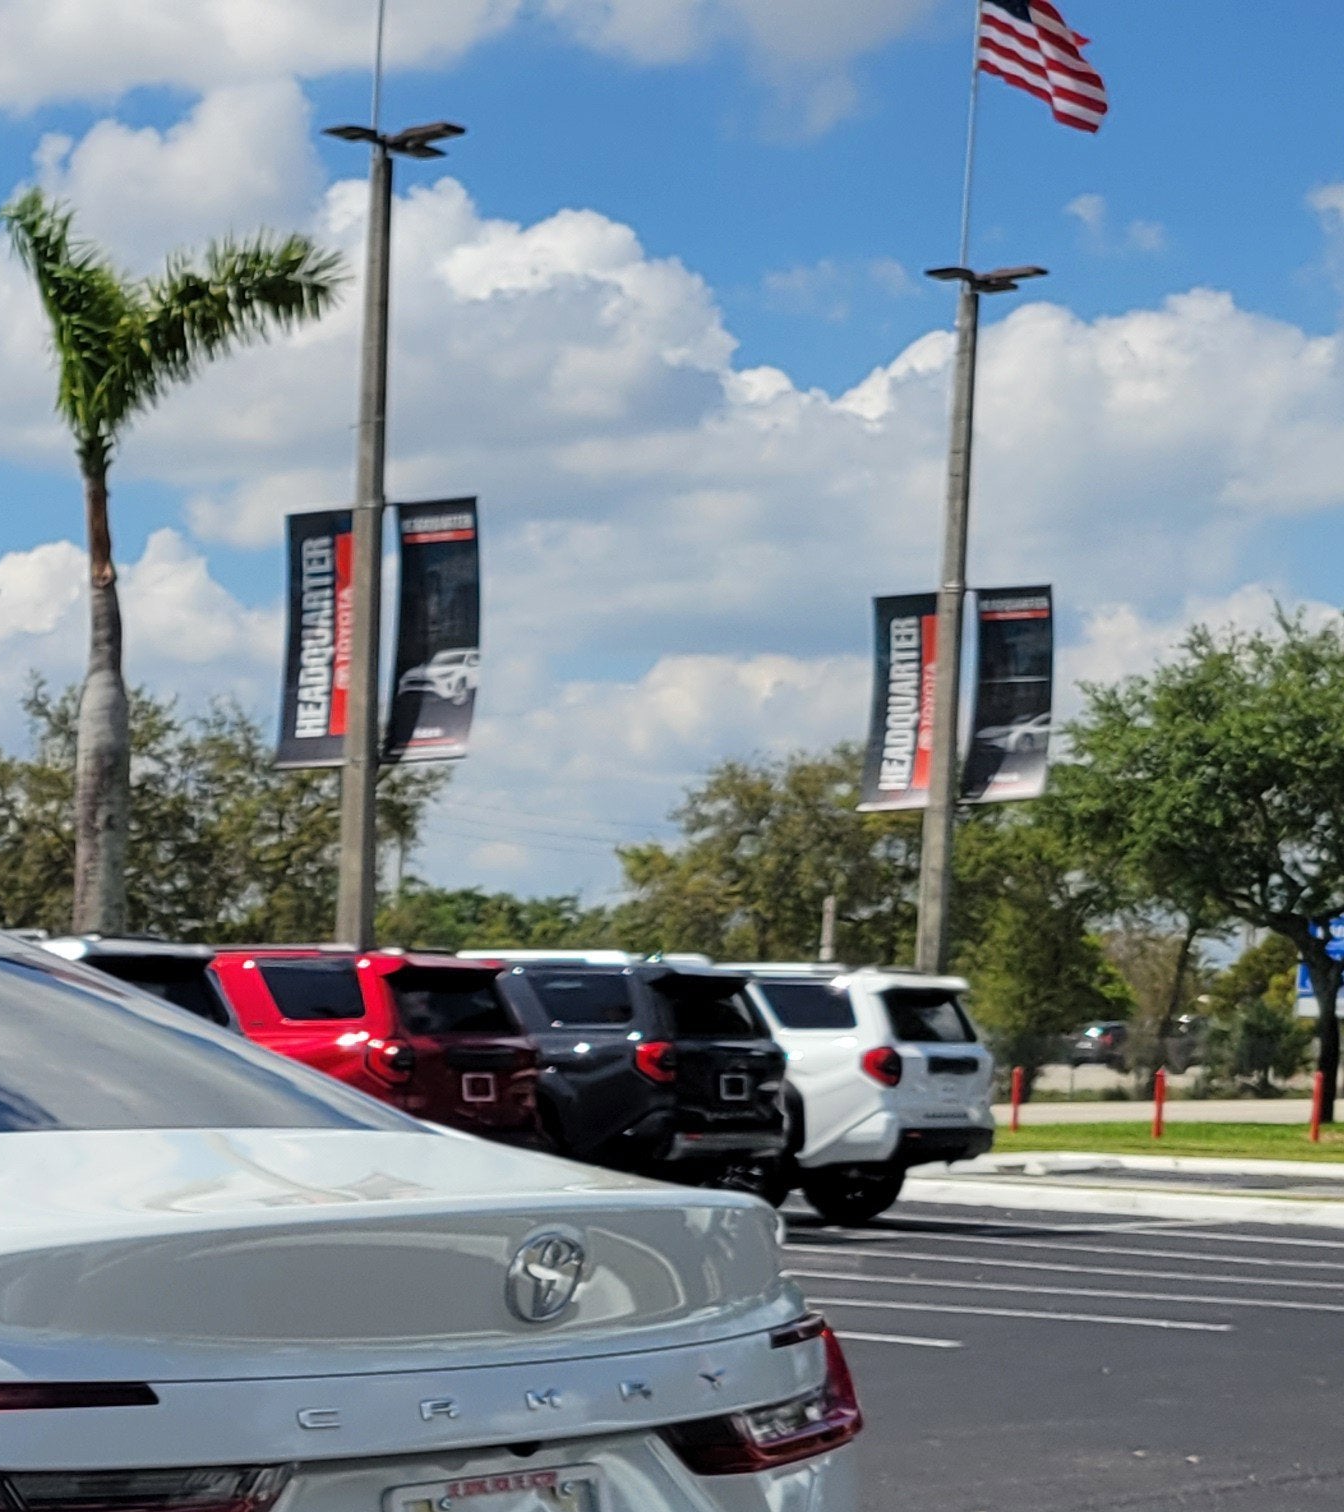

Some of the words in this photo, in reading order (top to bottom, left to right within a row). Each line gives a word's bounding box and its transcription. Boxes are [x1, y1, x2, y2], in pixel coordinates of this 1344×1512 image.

[294, 535, 334, 739] HEADQUARTER
[878, 615, 921, 791] HEADQUARTER
[296, 1367, 726, 1428] CAMRY
